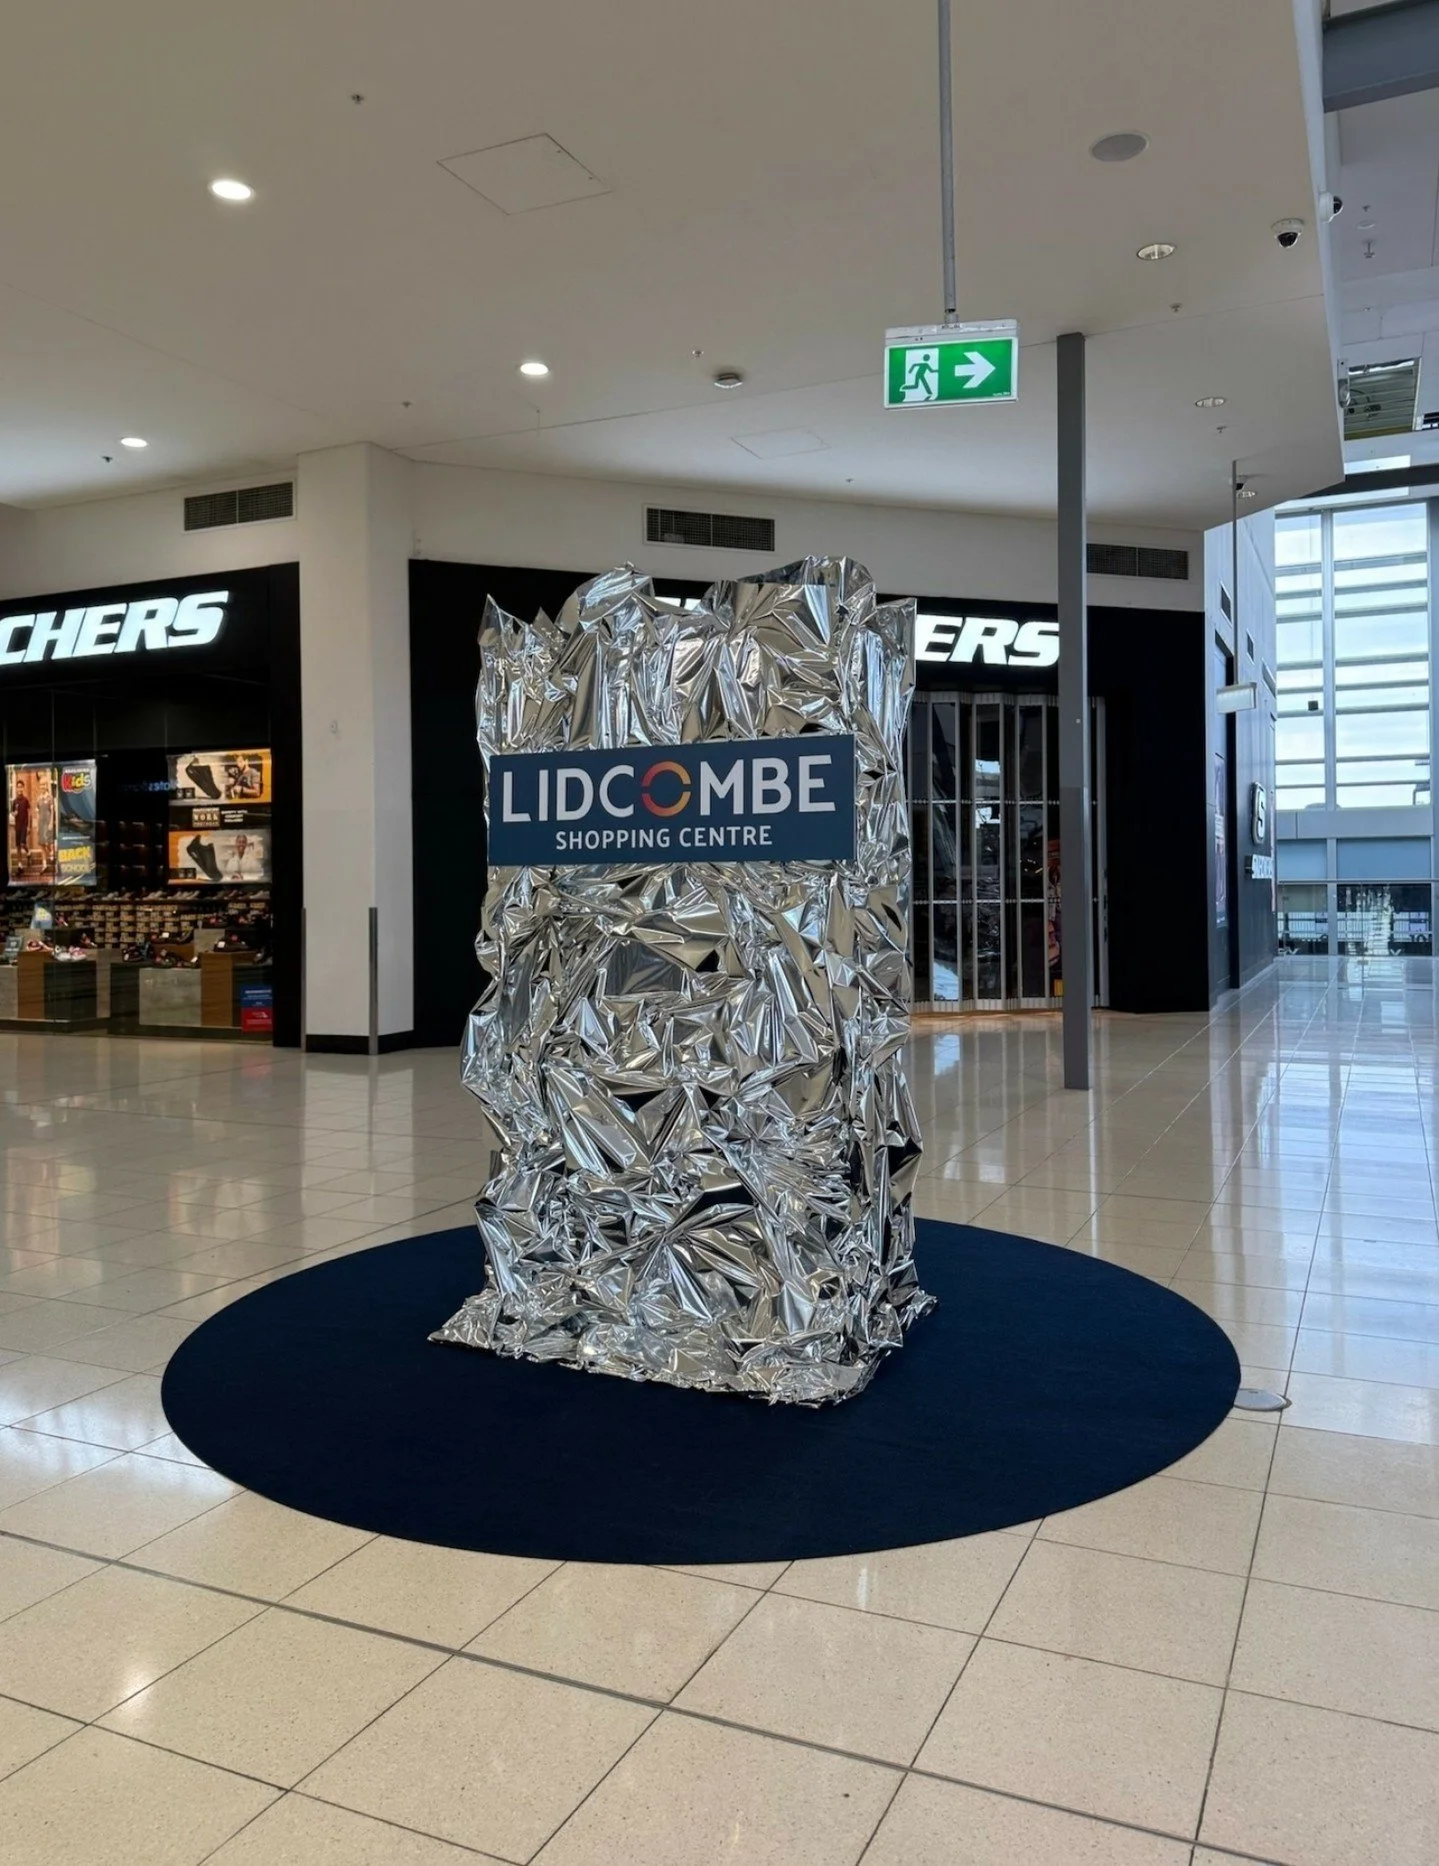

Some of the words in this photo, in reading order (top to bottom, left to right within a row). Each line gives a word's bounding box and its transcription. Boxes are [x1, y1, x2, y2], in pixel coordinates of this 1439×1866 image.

[62, 773, 91, 792] Kids
[502, 754, 837, 823] LIDCOMBE
[555, 827, 671, 850] SHOPPING
[678, 825, 773, 848] CENTRE
[58, 846, 91, 862] BACK
